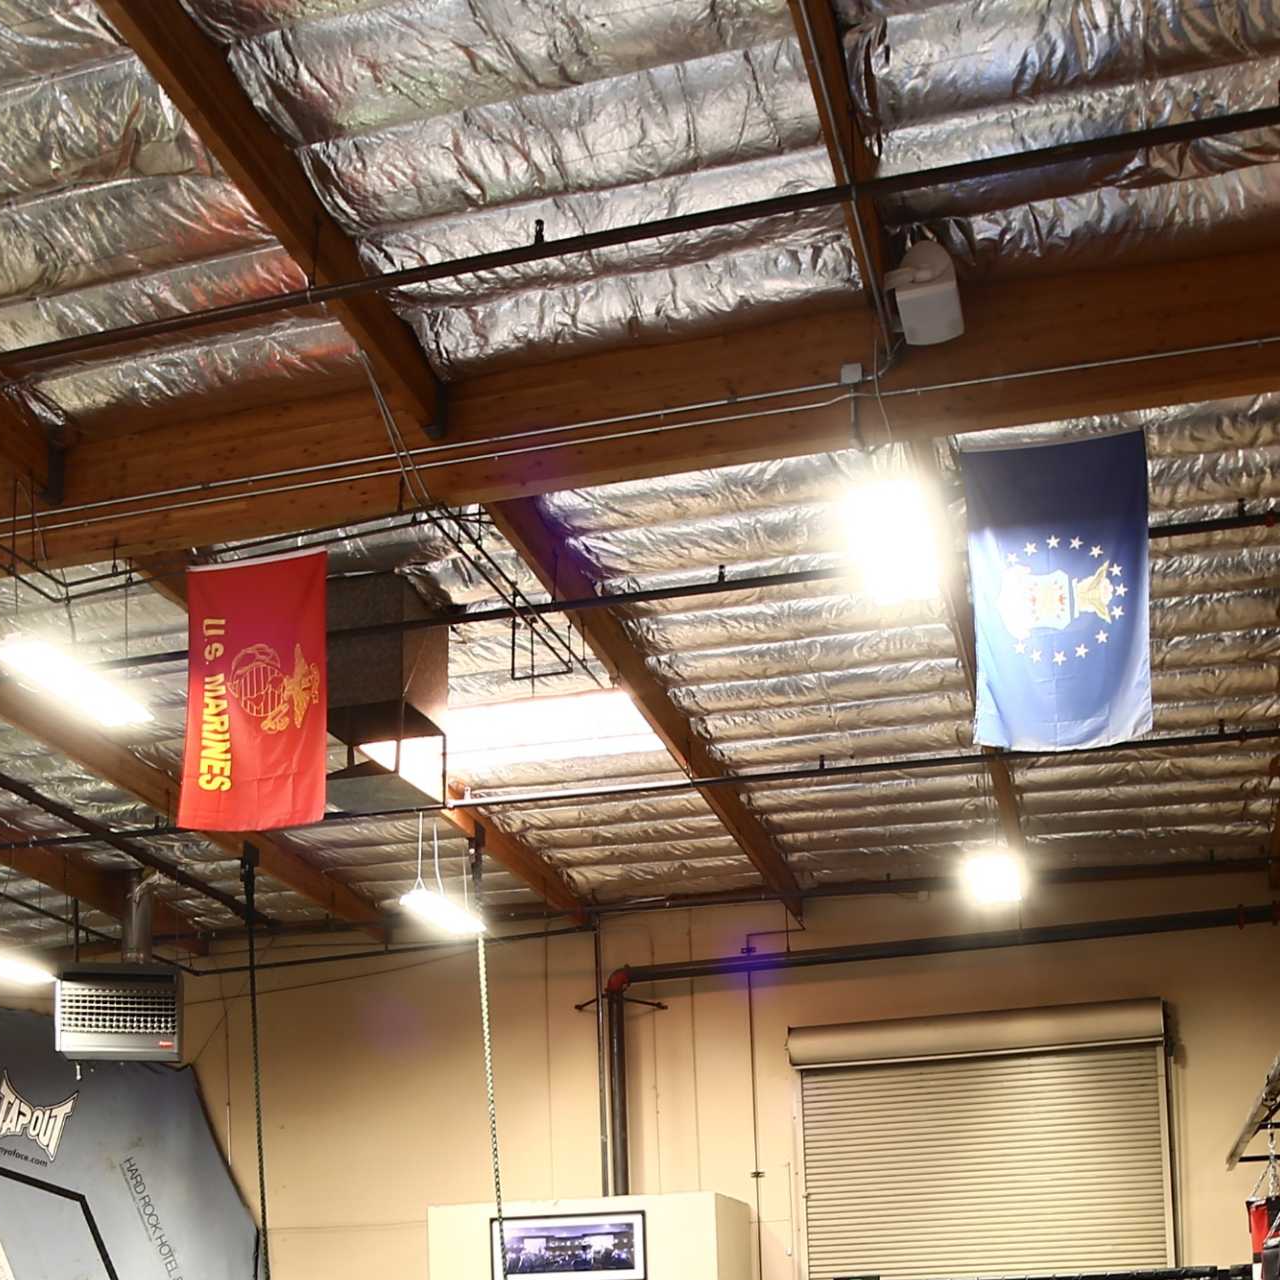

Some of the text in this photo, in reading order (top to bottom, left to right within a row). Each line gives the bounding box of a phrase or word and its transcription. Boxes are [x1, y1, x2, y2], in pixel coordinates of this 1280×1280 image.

[198, 618, 232, 792] U.S. MARINES
[124, 1156, 146, 1194] HARD
[139, 1195, 162, 1236] ROCK
[156, 1234, 178, 1278] HOTEL
